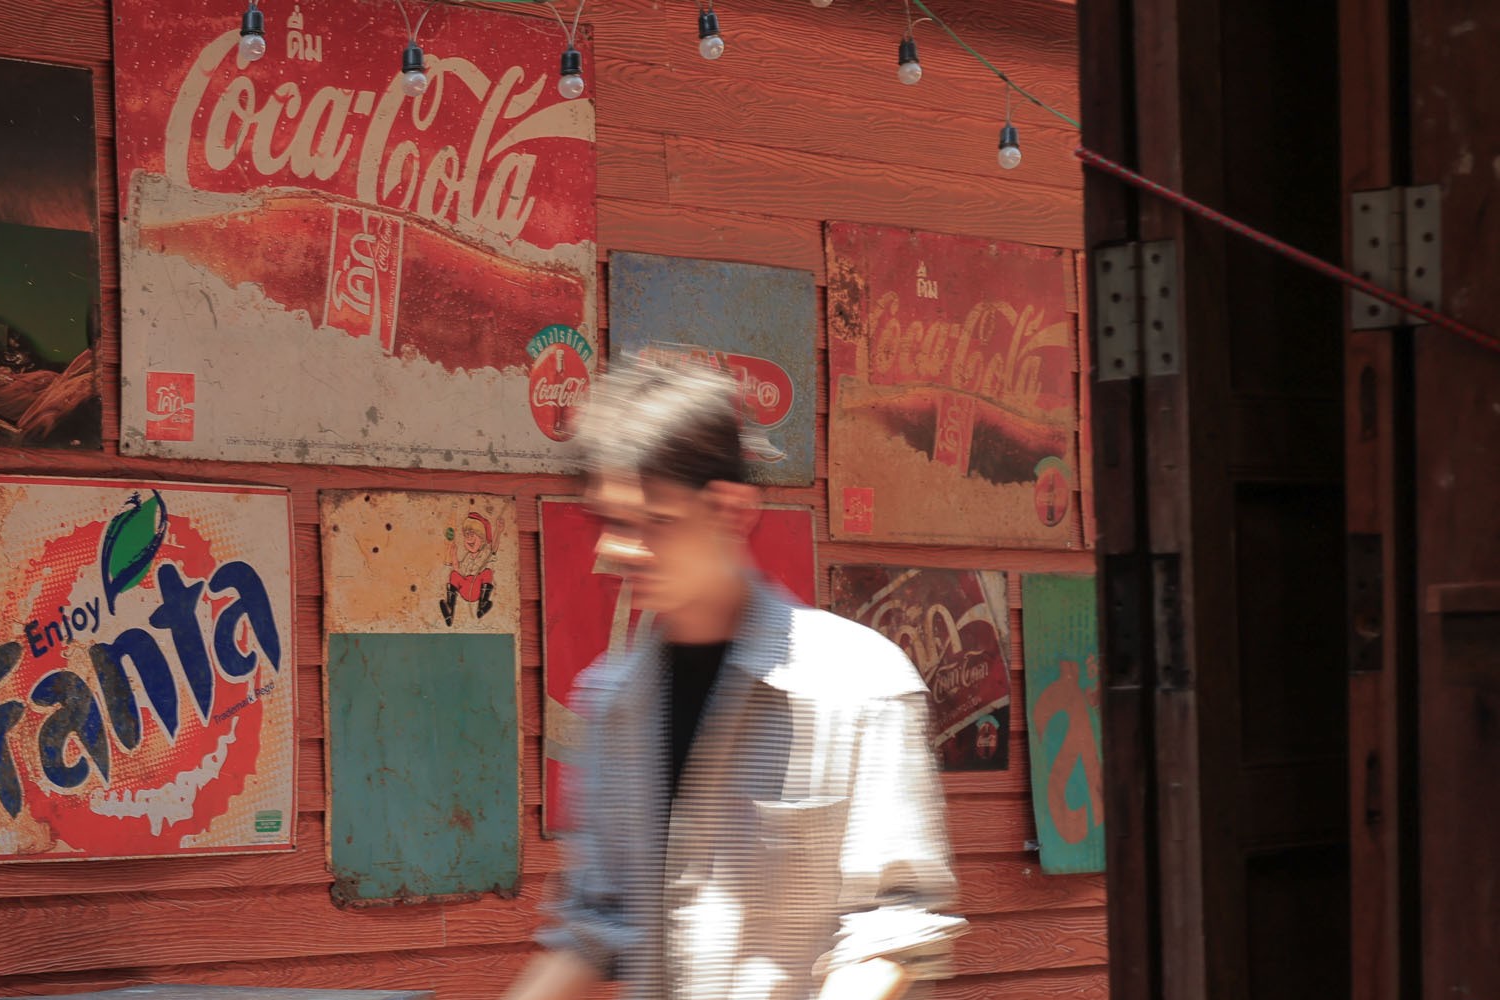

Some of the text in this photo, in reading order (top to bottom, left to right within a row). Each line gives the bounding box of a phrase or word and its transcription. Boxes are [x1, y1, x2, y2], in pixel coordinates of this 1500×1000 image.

[286, 6, 323, 62] ดื่ม
[165, 28, 550, 242] Coca-Cola
[858, 291, 1049, 404] Coca-Cola
[24, 596, 101, 659] Enjoy
